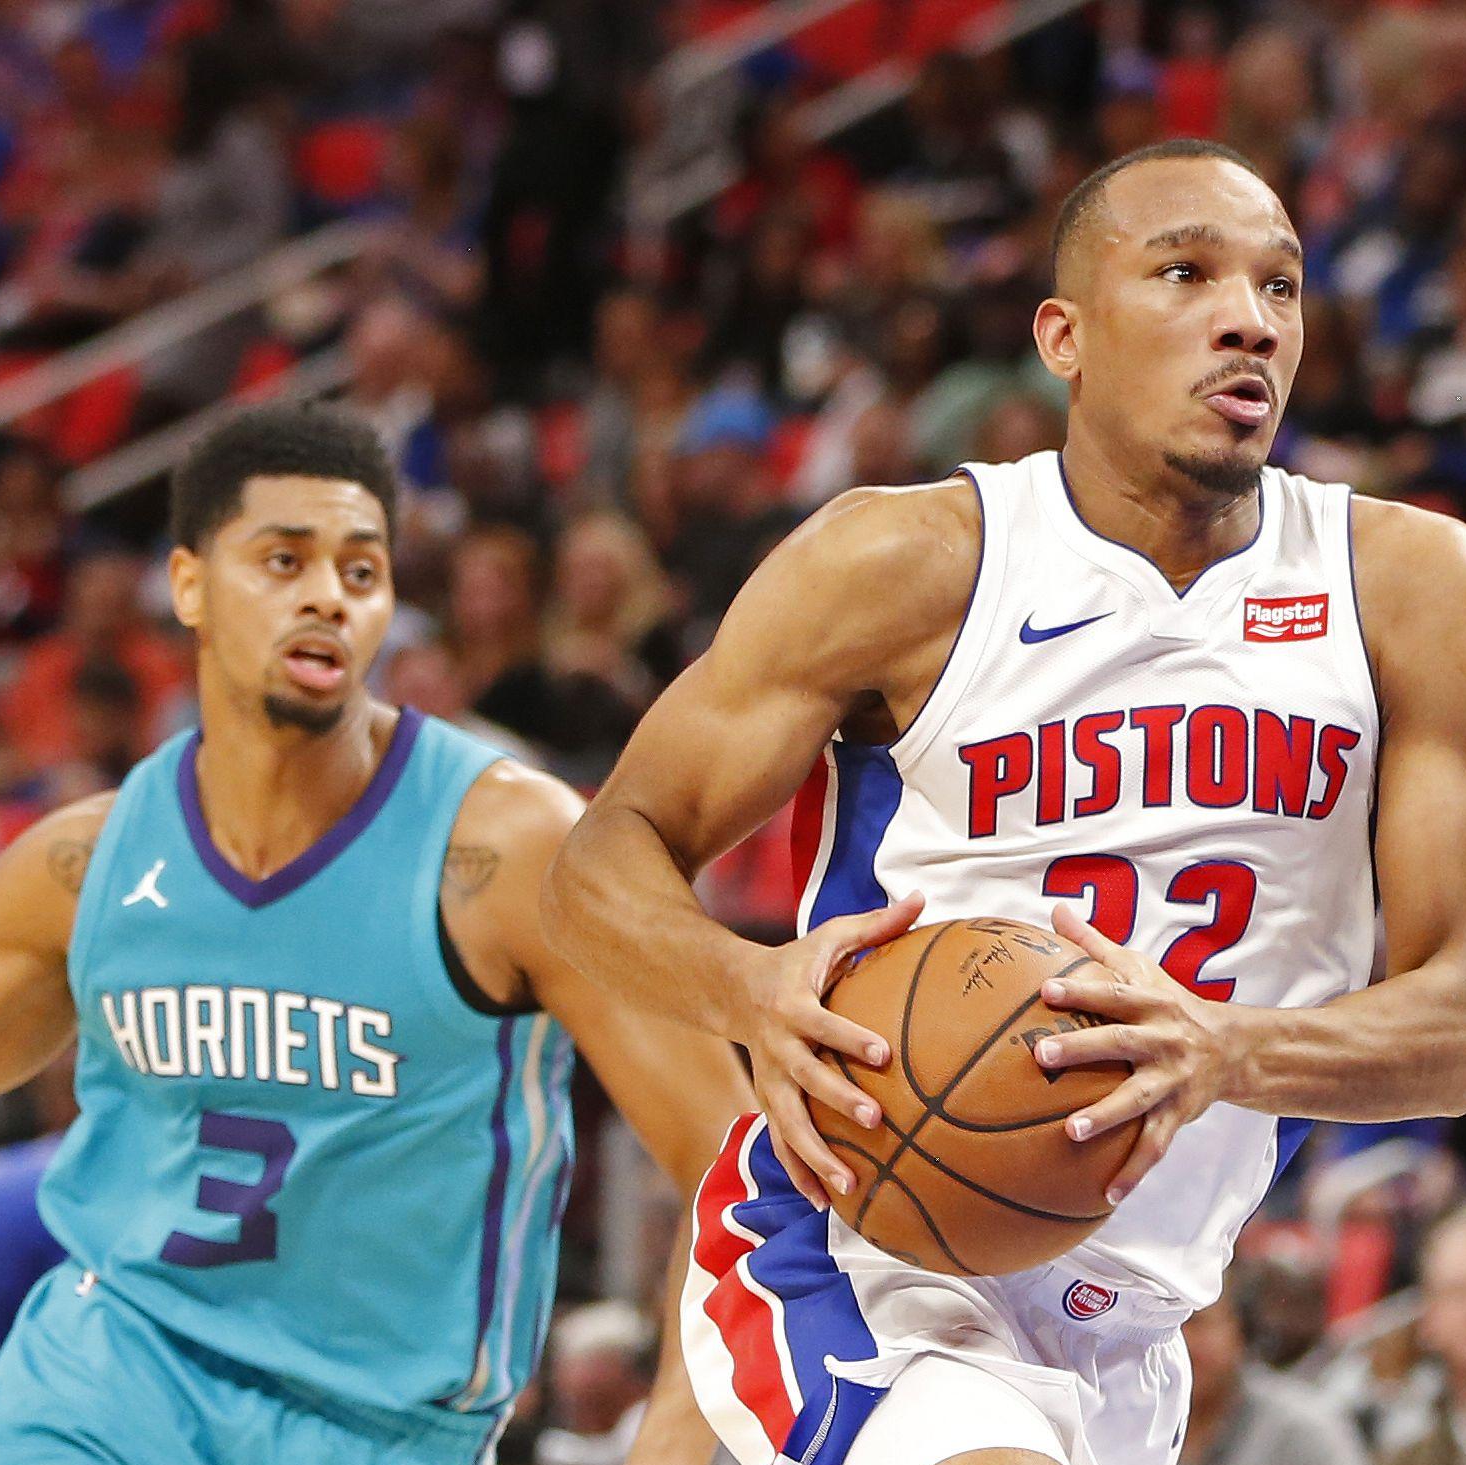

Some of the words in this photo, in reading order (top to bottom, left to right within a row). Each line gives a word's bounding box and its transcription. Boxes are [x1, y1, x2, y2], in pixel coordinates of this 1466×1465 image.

[1246, 602, 1324, 625] Flagstar
[1293, 621, 1322, 635] Bank
[958, 703, 1361, 840] PISTONS
[101, 985, 398, 1097] HORNETS
[159, 1111, 296, 1268] 3
